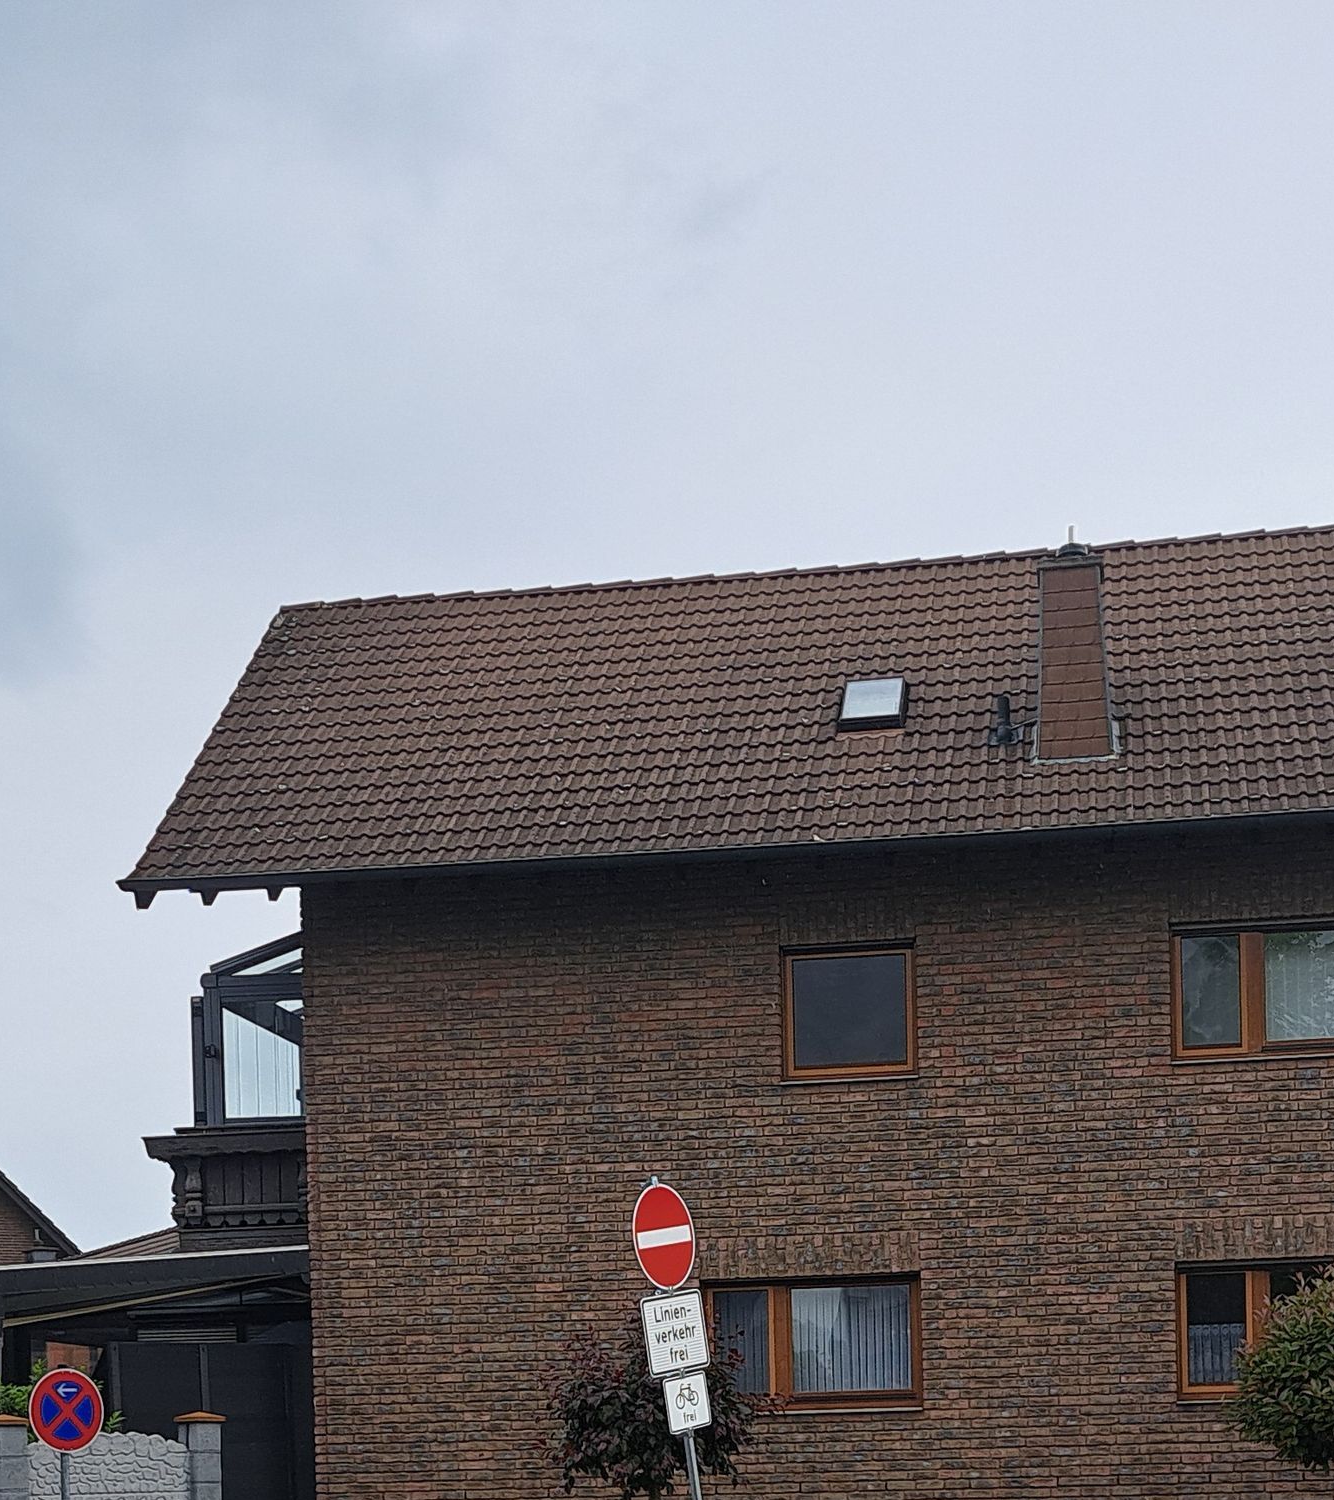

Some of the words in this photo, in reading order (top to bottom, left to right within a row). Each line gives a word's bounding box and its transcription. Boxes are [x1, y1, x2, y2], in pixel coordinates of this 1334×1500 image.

[653, 1304, 692, 1323] Linien-
[655, 1323, 696, 1344] verkehr
[670, 1344, 688, 1364] frei
[683, 1409, 697, 1424] frei
